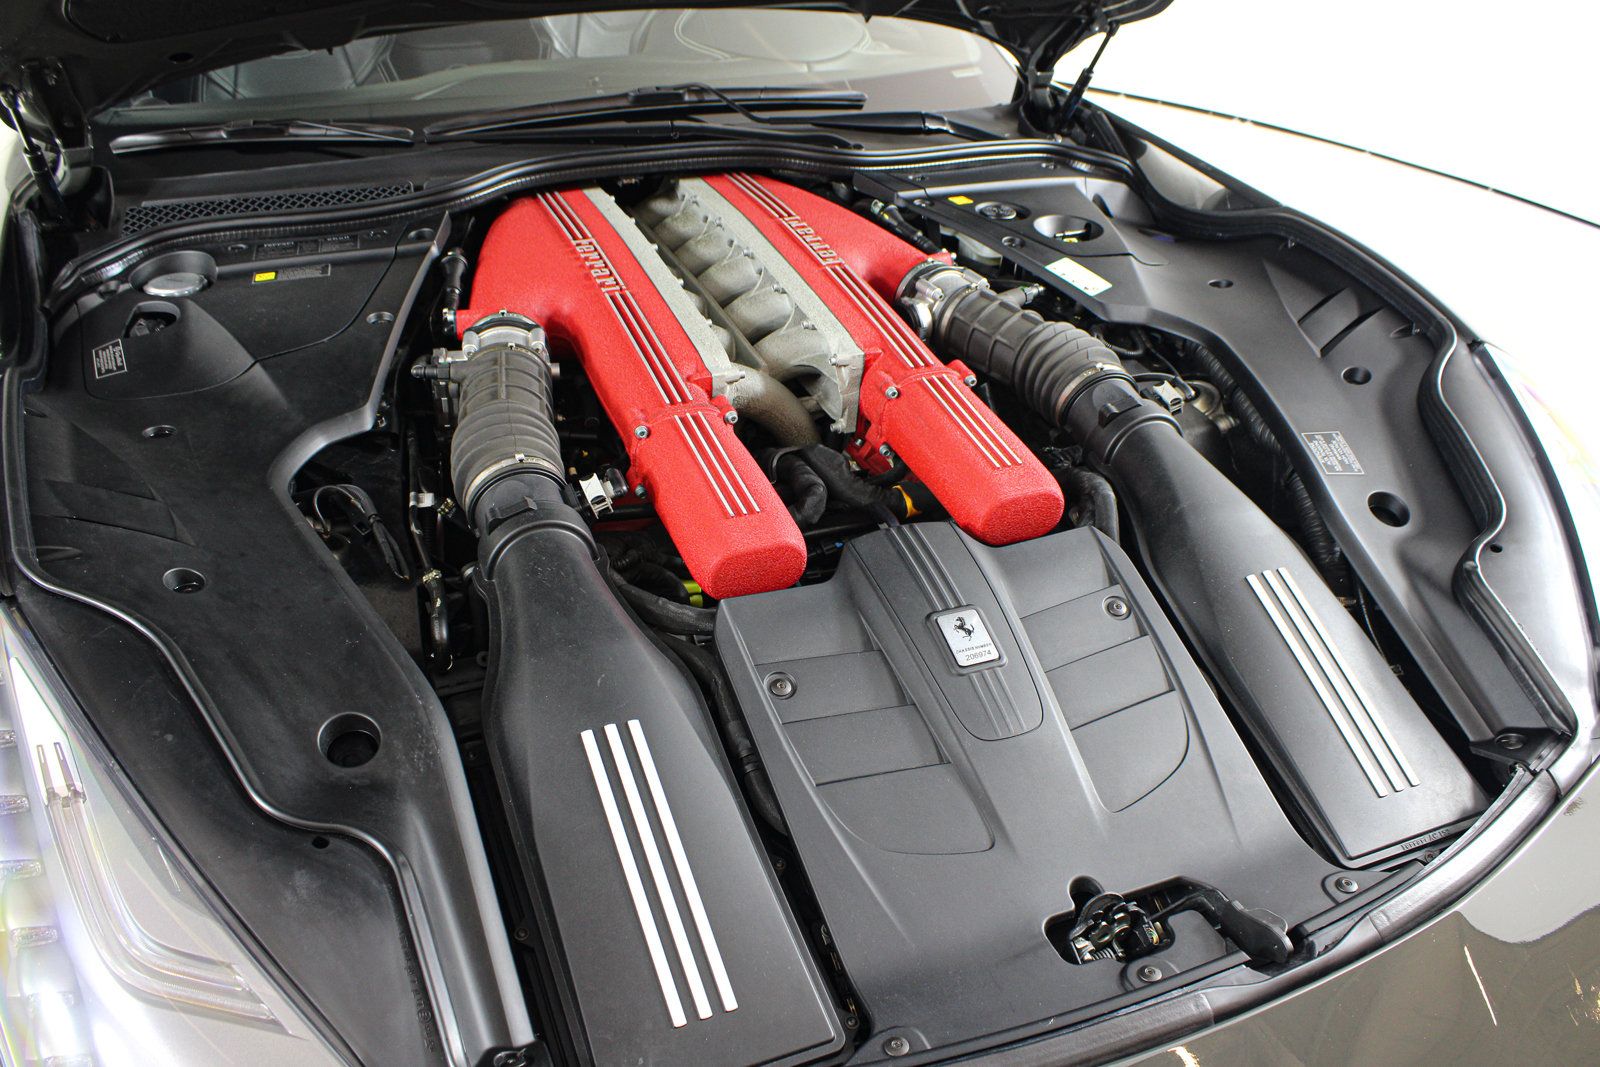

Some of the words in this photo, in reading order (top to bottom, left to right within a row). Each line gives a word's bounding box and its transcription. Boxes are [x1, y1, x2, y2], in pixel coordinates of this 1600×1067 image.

[779, 215, 845, 266] Ferrari
[571, 238, 627, 293] Ferrari
[956, 646, 975, 654] CHASSIS
[975, 642, 992, 650] NUMBER
[965, 650, 991, 661] 206974
